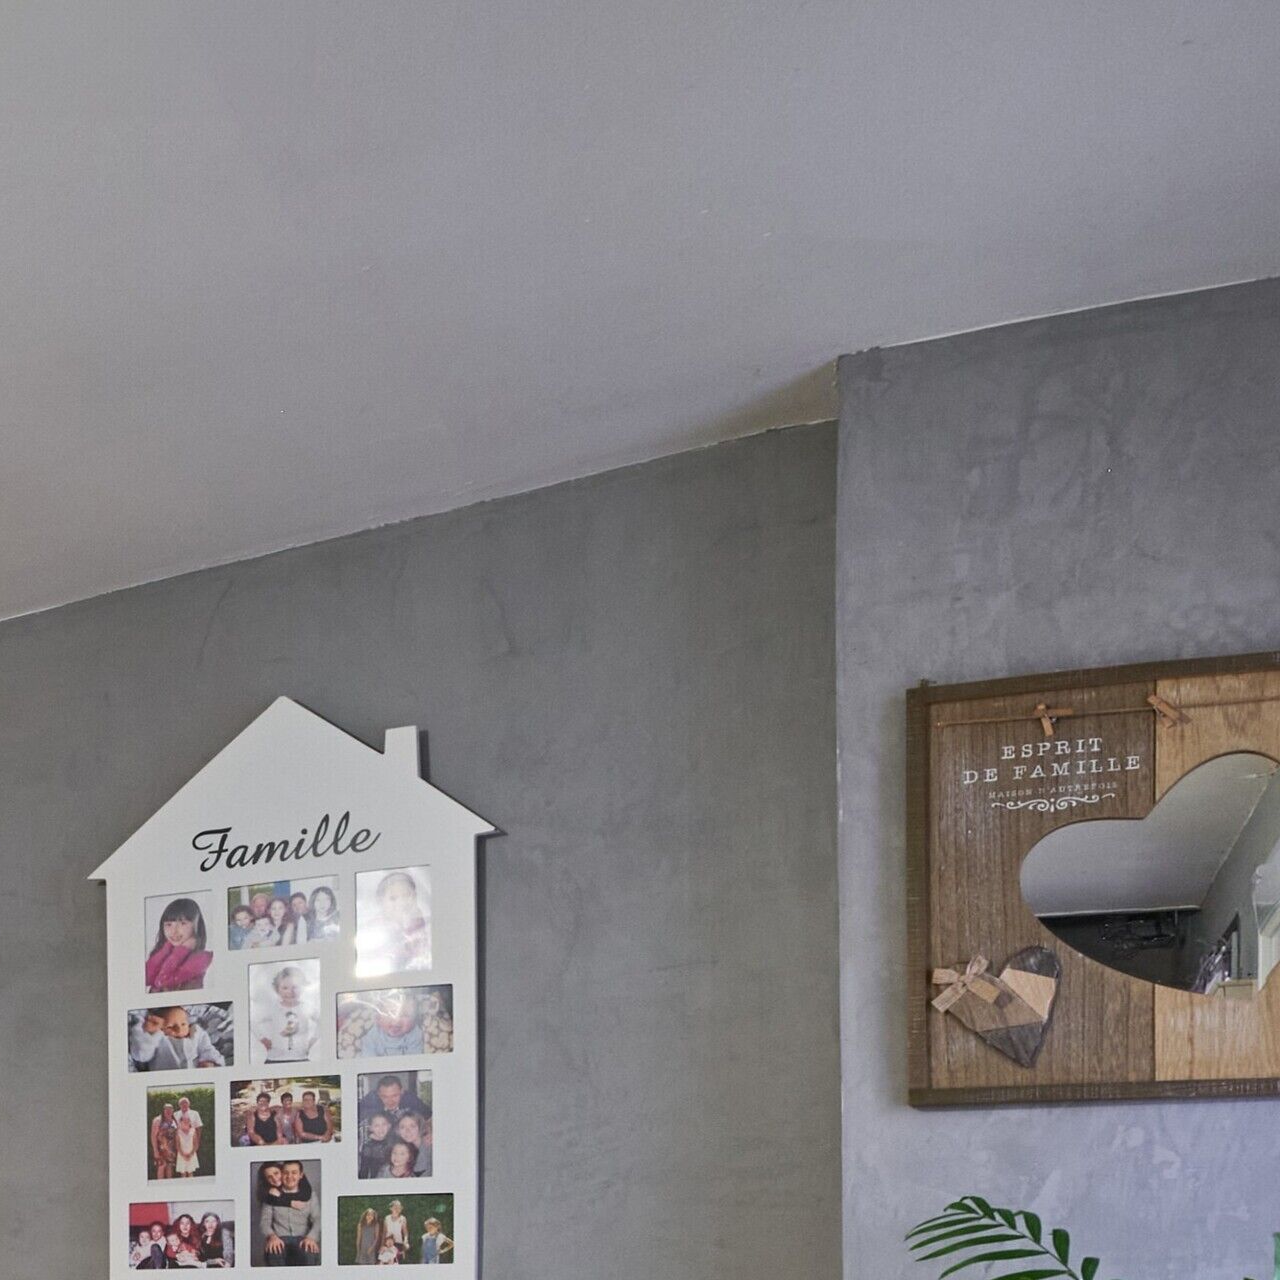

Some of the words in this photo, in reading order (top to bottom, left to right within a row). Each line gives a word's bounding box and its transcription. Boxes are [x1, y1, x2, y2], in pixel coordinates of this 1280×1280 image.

[1001, 738, 1102, 759] ESPRIT
[963, 768, 998, 784] DE
[1013, 756, 1140, 779] FAMILLE
[989, 789, 1033, 799] MAISON
[192, 811, 381, 872] Famille
